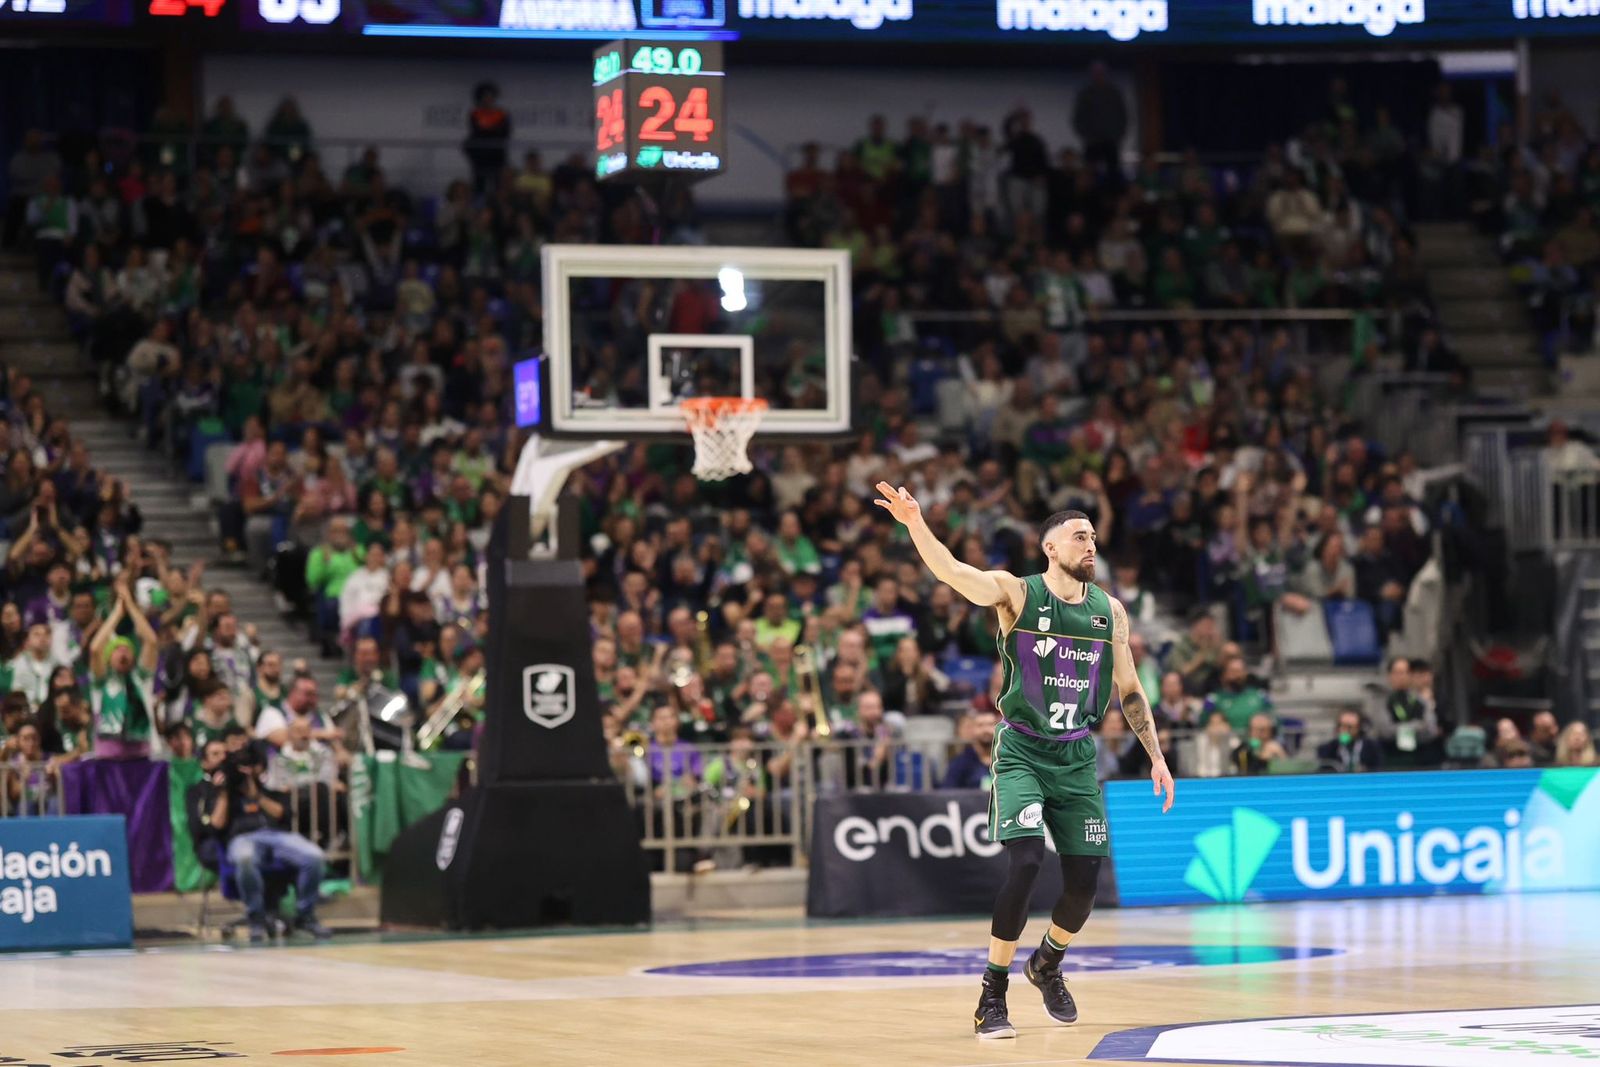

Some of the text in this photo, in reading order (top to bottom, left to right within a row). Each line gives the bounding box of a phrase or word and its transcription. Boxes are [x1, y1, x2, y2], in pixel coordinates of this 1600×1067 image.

[631, 46, 702, 75] 49.0
[638, 85, 714, 142] 24
[1049, 702, 1078, 730] 27
[1085, 831, 1107, 846] laga
[1291, 809, 1565, 890] Unicaja
